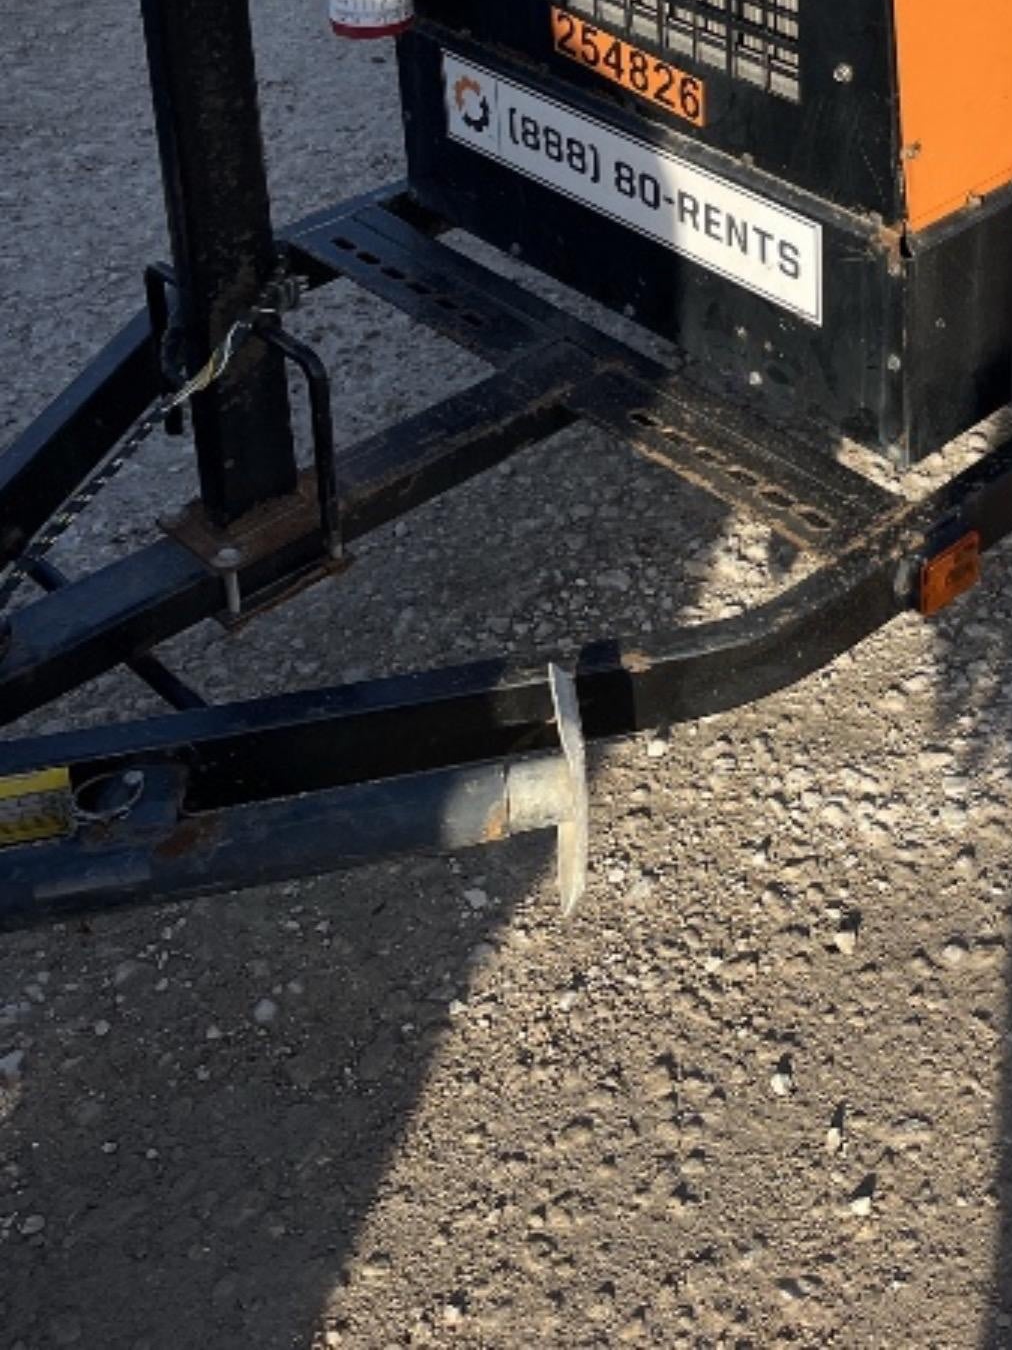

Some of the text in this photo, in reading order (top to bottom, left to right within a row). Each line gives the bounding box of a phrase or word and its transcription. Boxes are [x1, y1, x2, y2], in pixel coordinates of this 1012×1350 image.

[556, 13, 701, 120] 254826
[508, 106, 802, 281] (888) 80-RENTS
